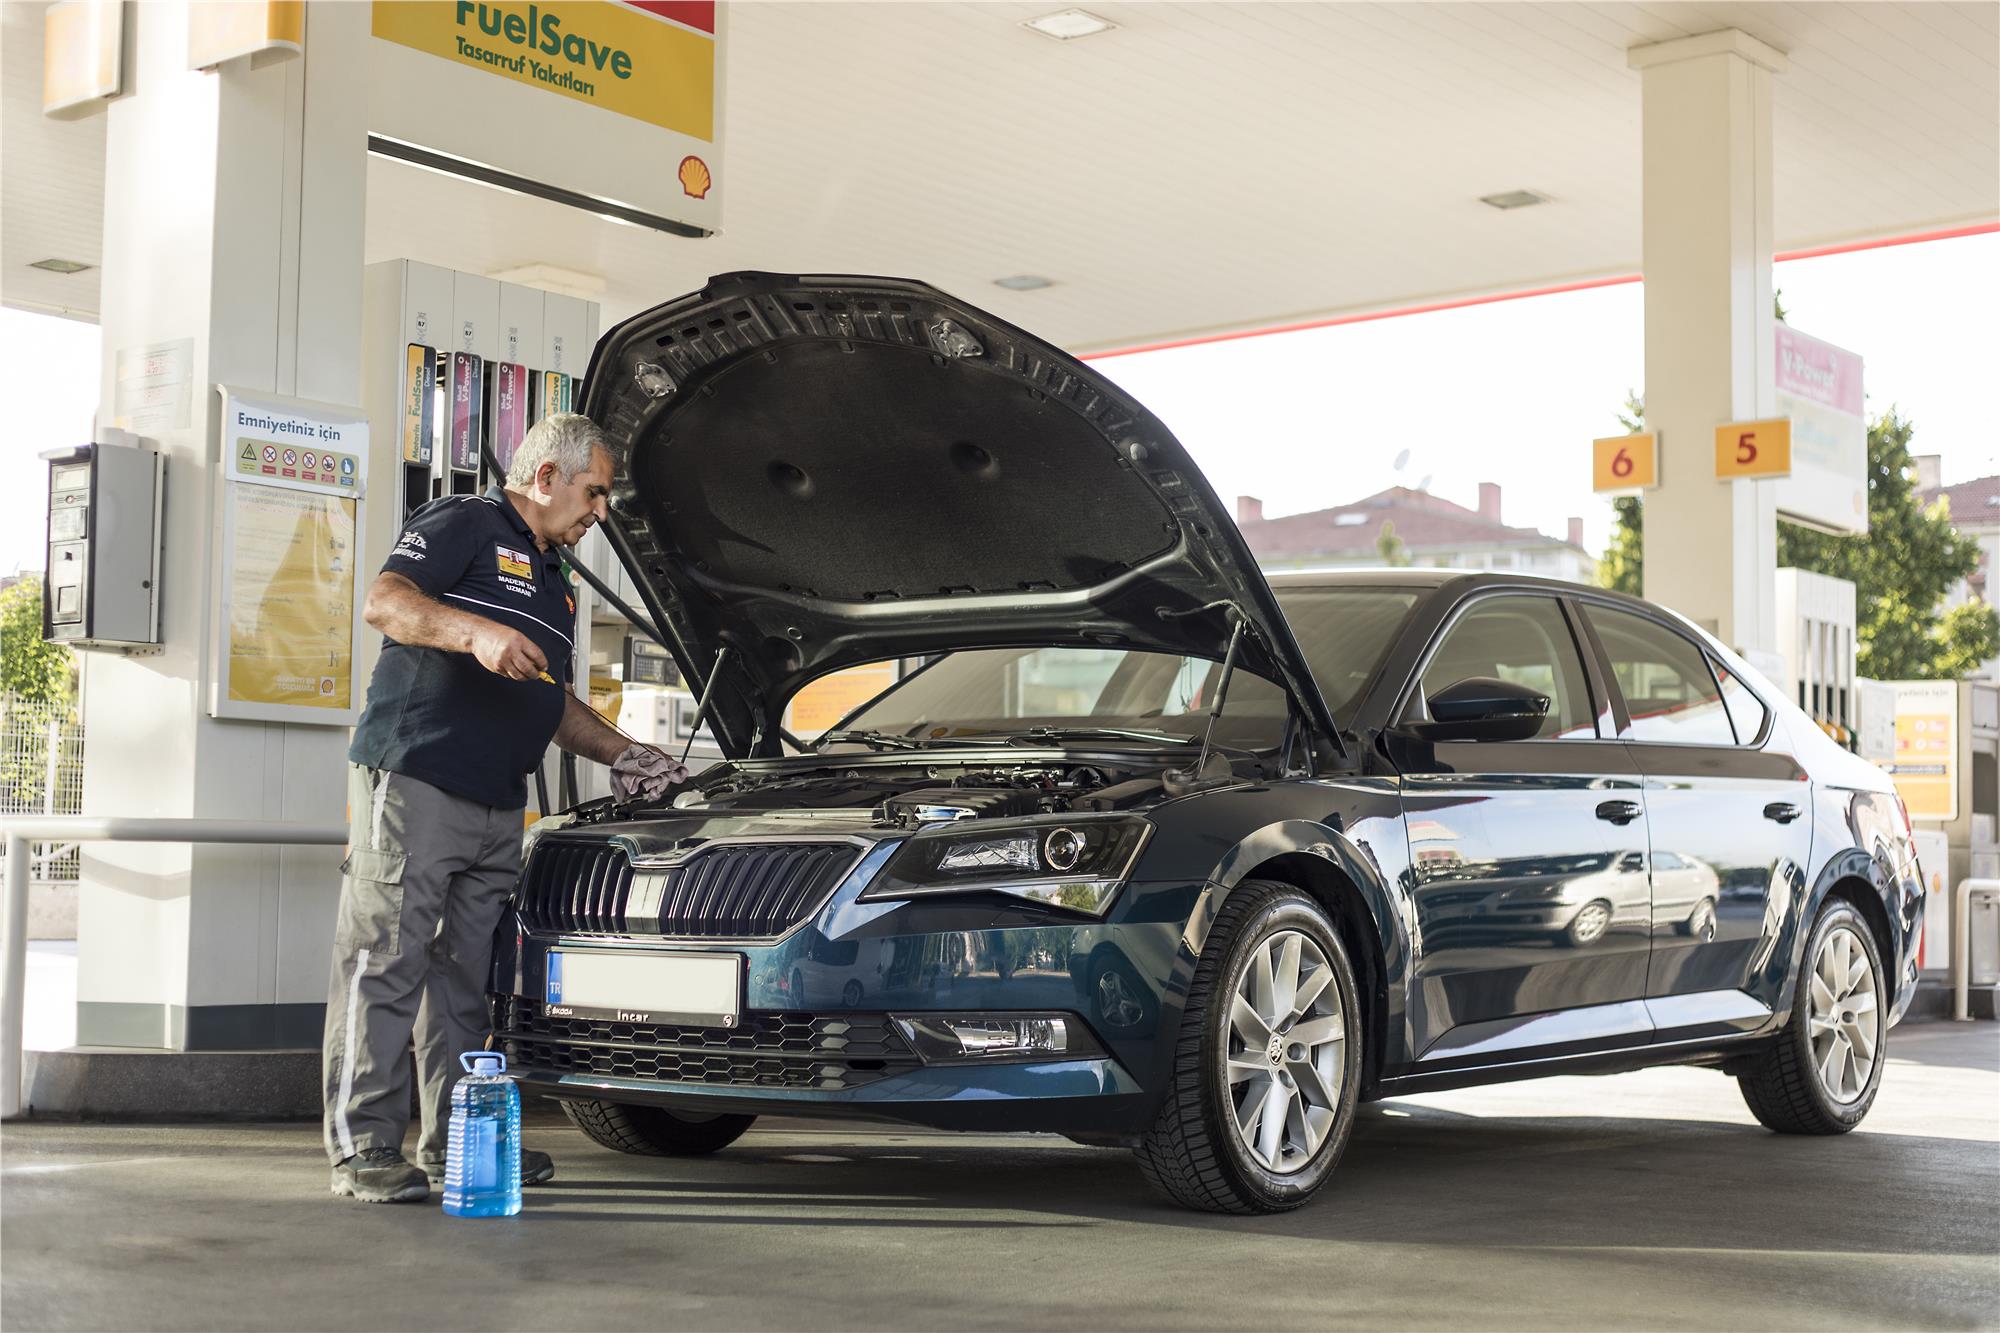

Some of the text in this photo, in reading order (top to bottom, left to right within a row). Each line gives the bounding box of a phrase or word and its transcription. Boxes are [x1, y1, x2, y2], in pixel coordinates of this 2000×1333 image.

[455, 0, 632, 79] FuelSave
[456, 36, 595, 96] Tasarruf Yakıtları
[412, 366, 423, 417] FuelSave
[424, 367, 432, 387] Diesel
[462, 361, 471, 402] V-Power
[506, 369, 514, 410] V-Power
[551, 376, 560, 414] elSave
[238, 412, 341, 441] Emniyetiniz için
[411, 424, 420, 459] Motorin
[460, 431, 468, 466] Motorin
[1612, 448, 1634, 478] 6
[1736, 433, 1757, 465] 5
[549, 982, 561, 995] TR
